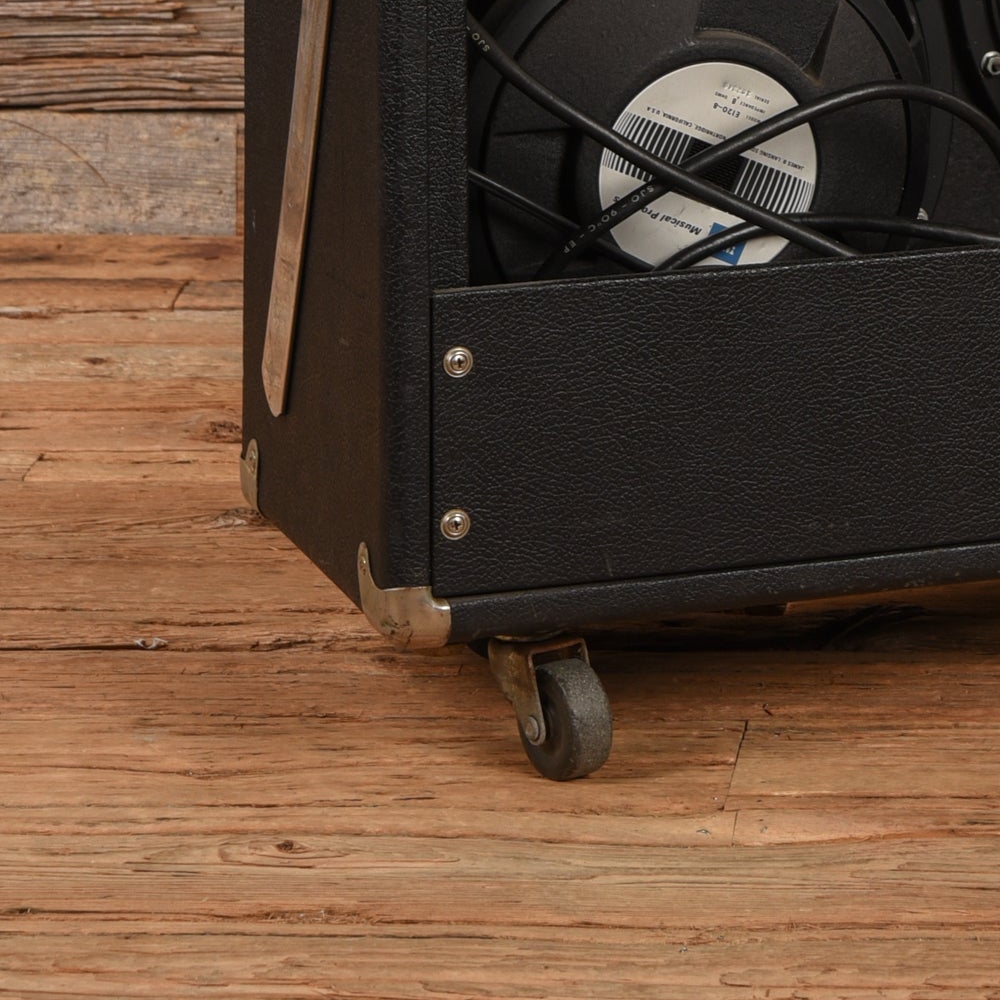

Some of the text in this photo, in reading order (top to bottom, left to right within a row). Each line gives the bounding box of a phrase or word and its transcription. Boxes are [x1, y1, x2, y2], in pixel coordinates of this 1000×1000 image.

[472, 32, 490, 52] SJO
[713, 102, 740, 118] E120-8
[760, 150, 781, 162] LANSING
[788, 161, 804, 170] JAMES
[632, 185, 654, 202] SJO
[660, 215, 702, 235] Musical
